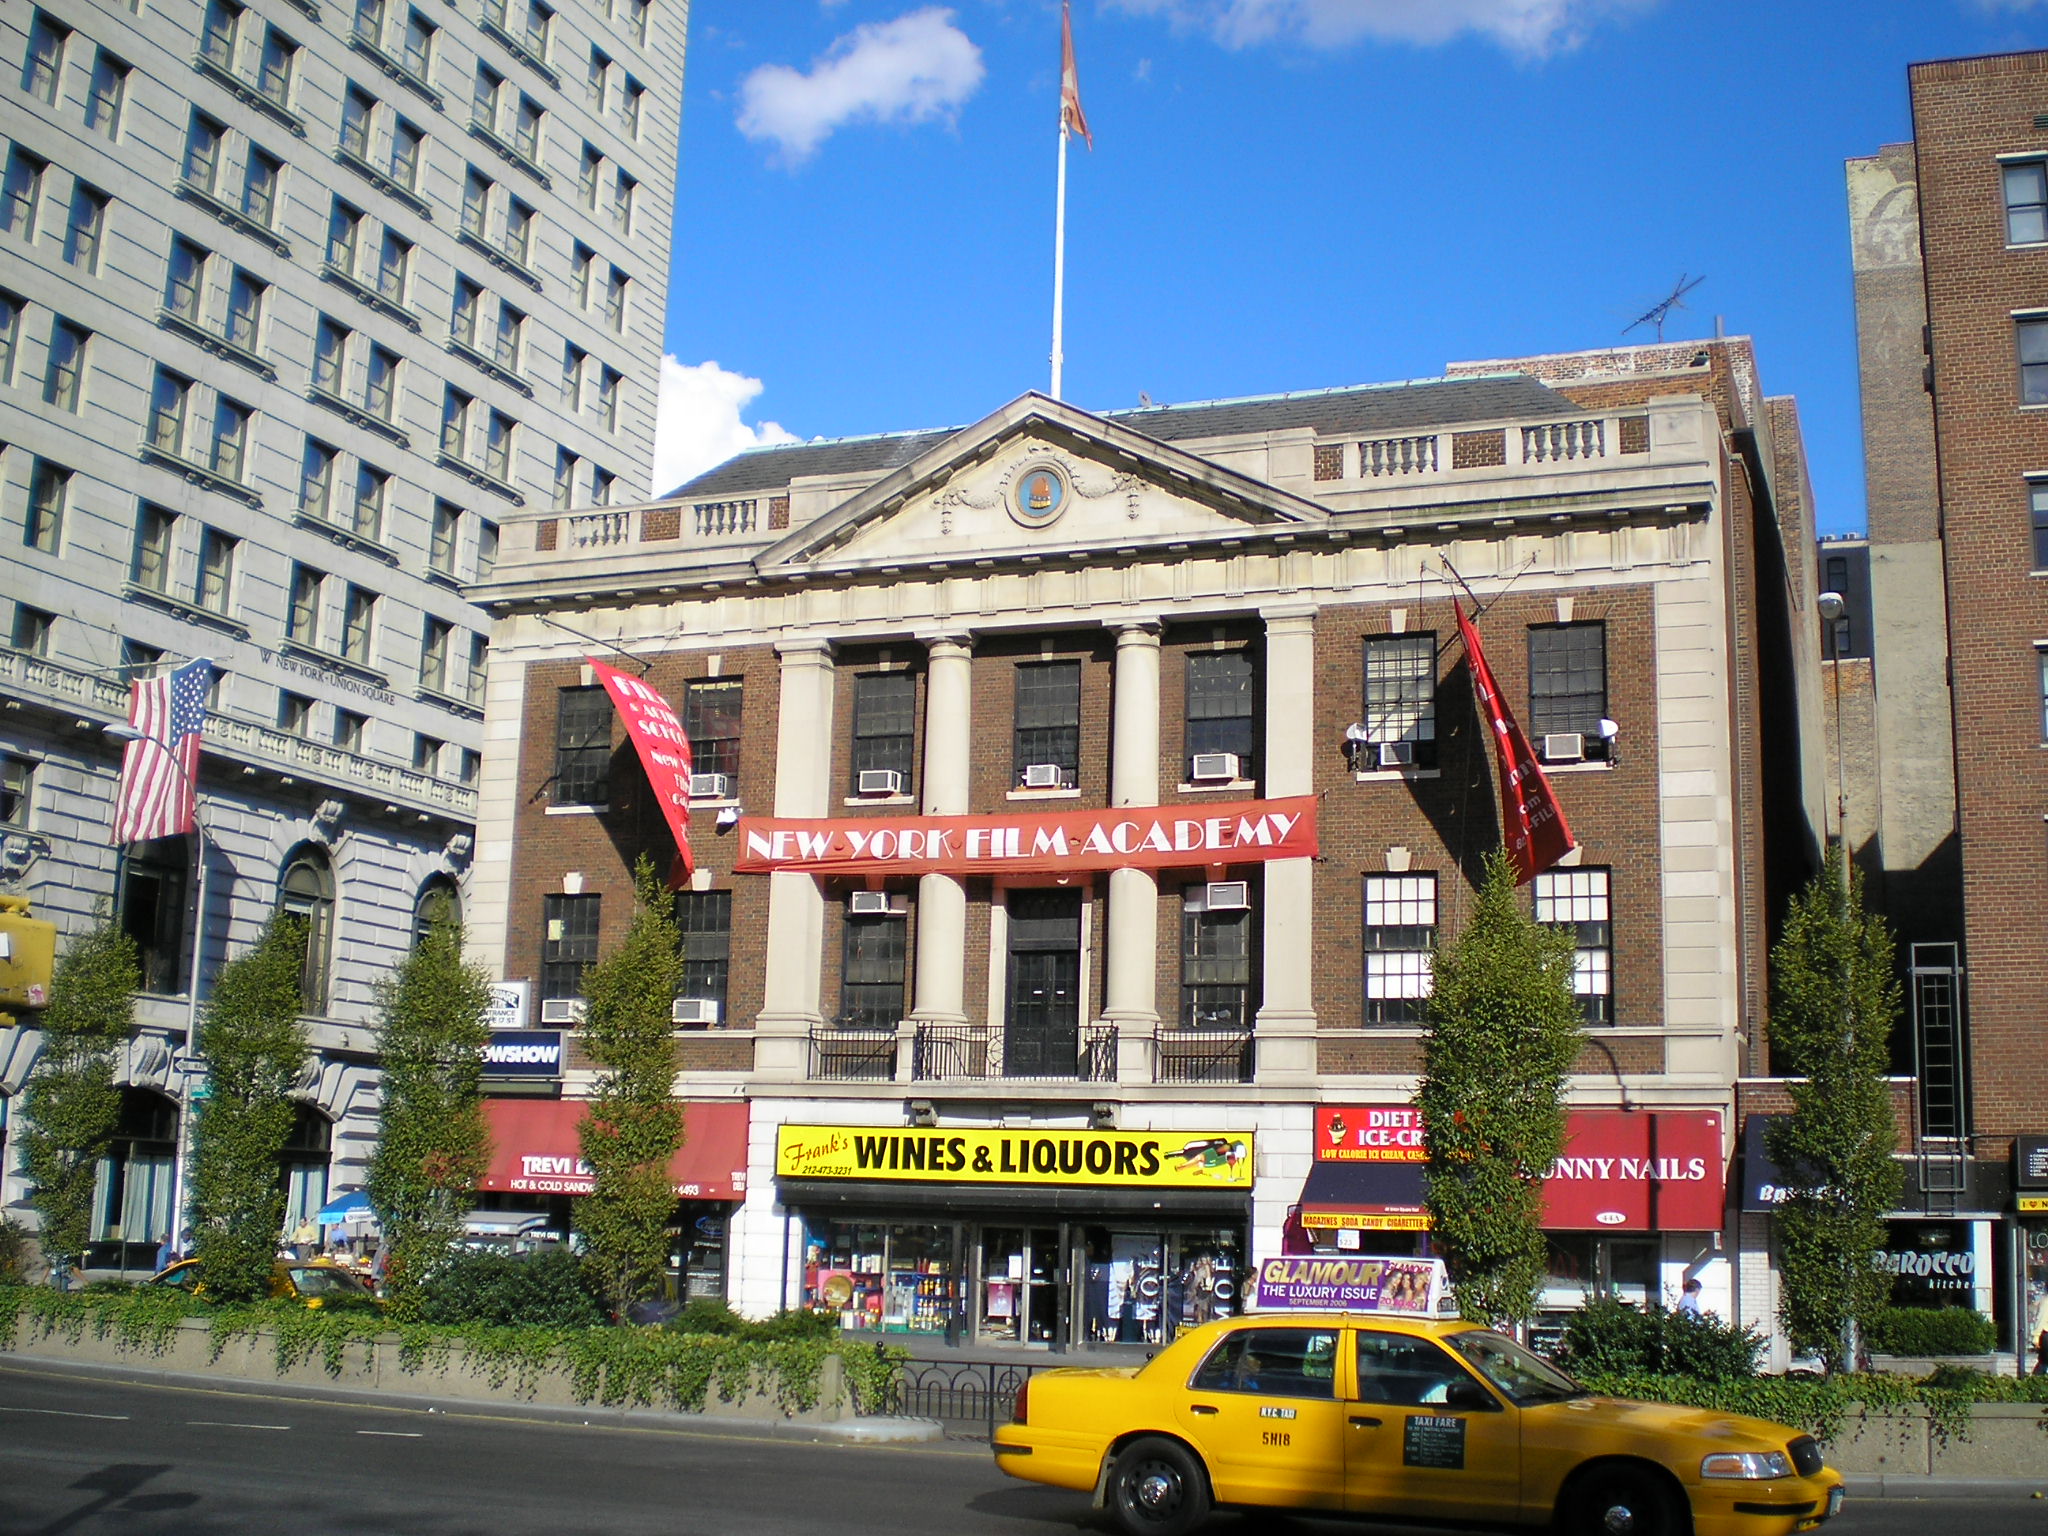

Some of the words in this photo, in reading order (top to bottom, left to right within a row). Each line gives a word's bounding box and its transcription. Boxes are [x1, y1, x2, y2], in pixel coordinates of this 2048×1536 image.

[260, 648, 272, 664] W
[276, 657, 299, 672] NEW
[300, 664, 324, 682] YORK
[330, 674, 360, 693] UNION
[362, 686, 395, 706] SQUARE
[747, 830, 833, 860] NEW
[845, 829, 952, 859] YORK
[965, 825, 1069, 858] FILM
[1080, 812, 1301, 855] ACADEMY
[1370, 1111, 1413, 1127] DIET
[1359, 1130, 1428, 1146] ICE-CR
[784, 1132, 848, 1171] Frank's
[854, 1135, 966, 1172] WINES
[972, 1145, 994, 1173] &
[1000, 1139, 1160, 1176] LIQUORS
[1321, 1149, 1337, 1158] LOW
[1339, 1149, 1367, 1159] CALORIE
[1369, 1150, 1379, 1159] ICE
[1381, 1150, 1406, 1160] CREAM,
[522, 1156, 570, 1176] TREVI
[802, 1165, 852, 1176] 212-473-3231
[1619, 1158, 1706, 1180] NAILS
[731, 1172, 746, 1181] TREVI
[511, 1180, 526, 1190] HOT
[529, 1180, 536, 1190] &
[538, 1181, 562, 1191] COLD
[733, 1182, 746, 1191] DELI
[1303, 1216, 1338, 1226] MAGAZINES
[1341, 1216, 1359, 1226] SODA
[1362, 1217, 1383, 1227] CANDY
[1387, 1218, 1424, 1228] CIGARETTES
[1264, 1260, 1384, 1286] GLAMOUR
[1262, 1285, 1285, 1297] THE
[1289, 1286, 1338, 1298] LUXURY
[1341, 1287, 1377, 1300] ISSUE
[1289, 1298, 1328, 1307] SEPTEMBER
[1415, 1416, 1433, 1426] TAXI
[1435, 1418, 1457, 1428] FARE
